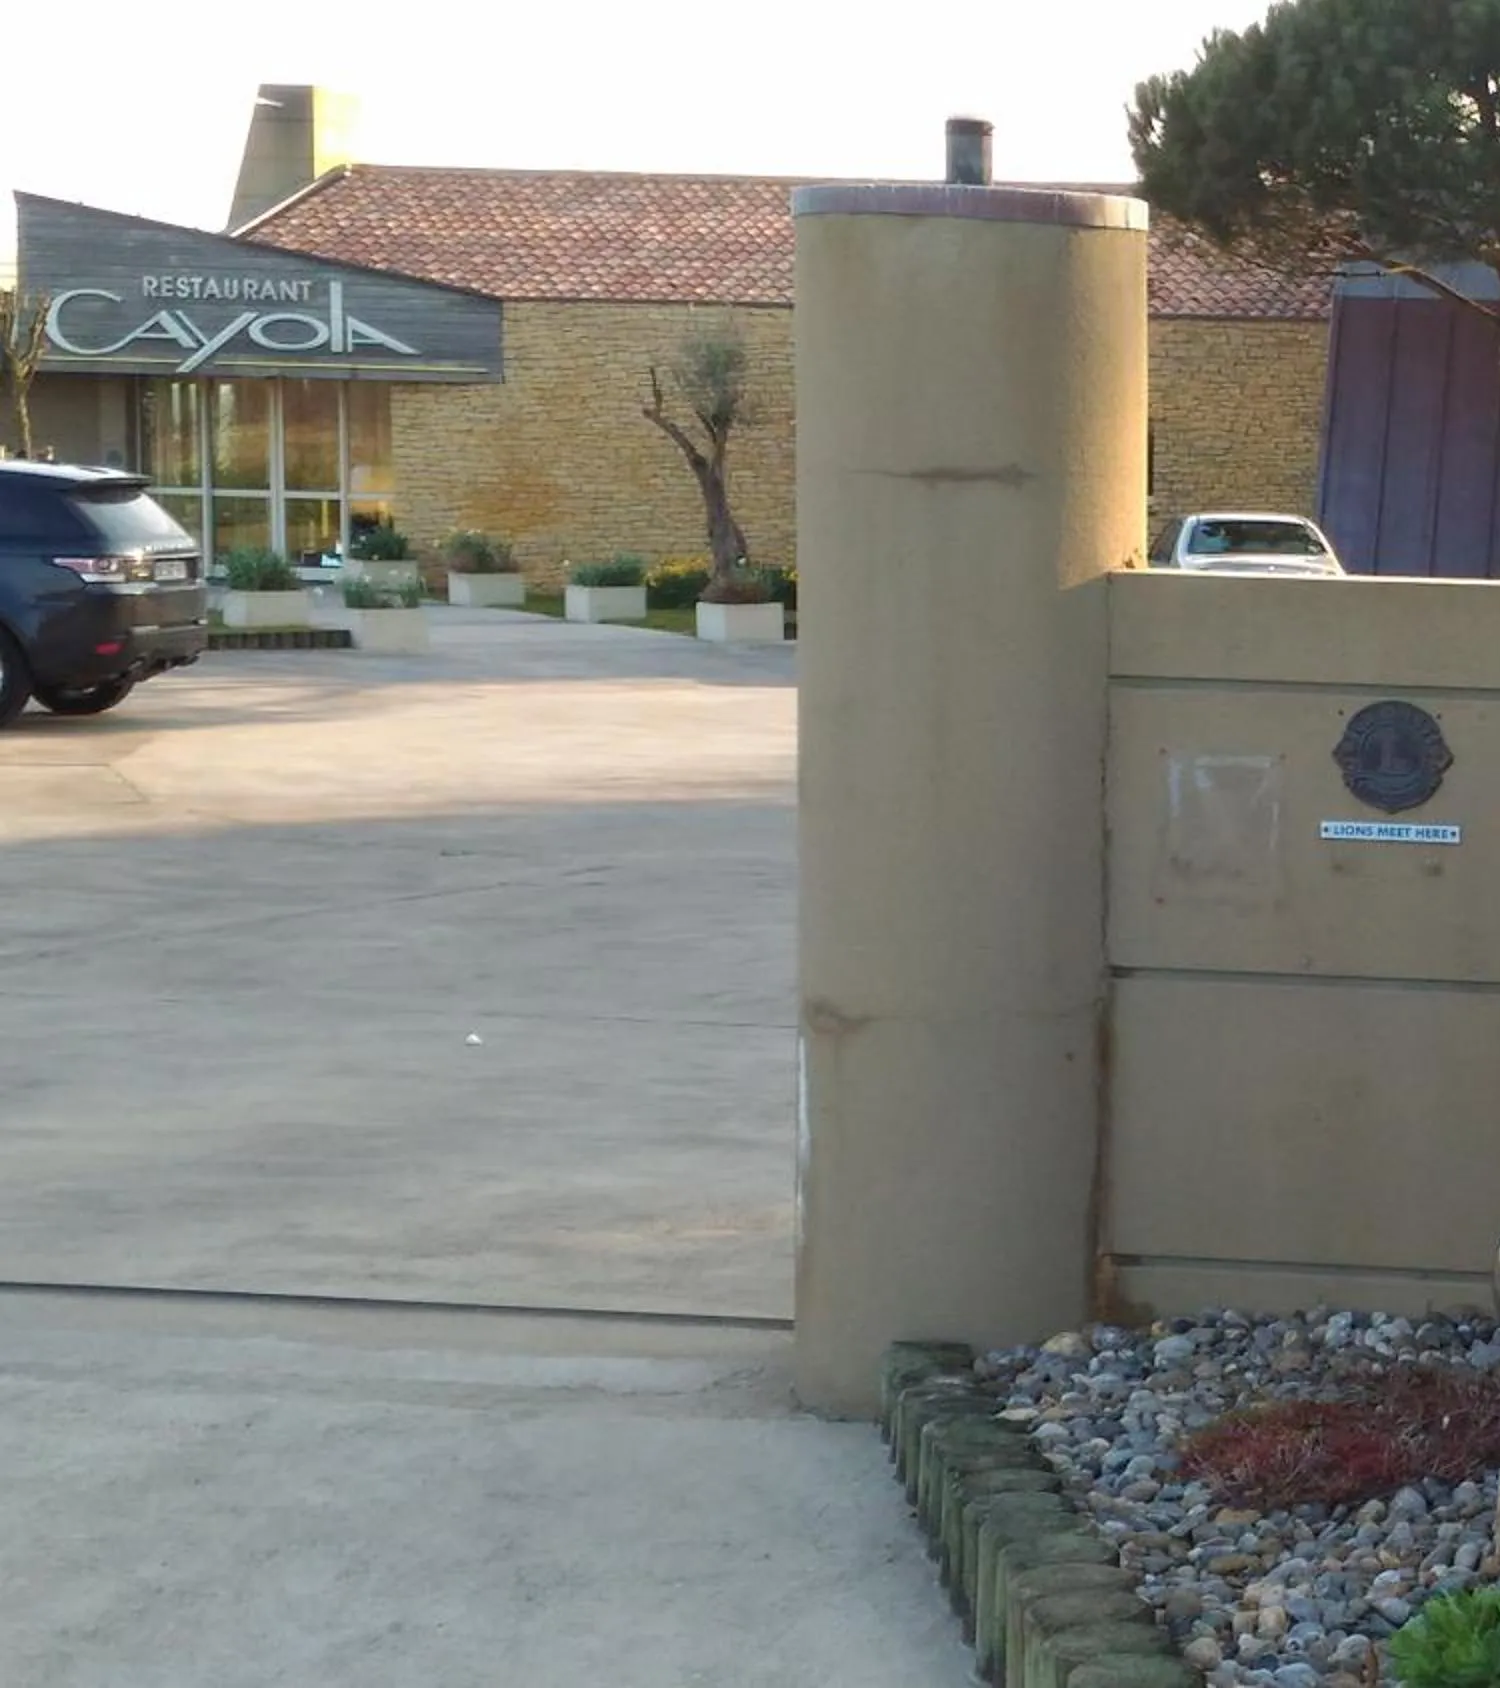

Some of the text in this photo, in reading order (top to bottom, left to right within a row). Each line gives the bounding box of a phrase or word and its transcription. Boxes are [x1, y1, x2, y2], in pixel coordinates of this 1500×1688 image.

[143, 275, 311, 301] RESTAURANT
[1333, 825, 1449, 839] LIONS MEET HERE
